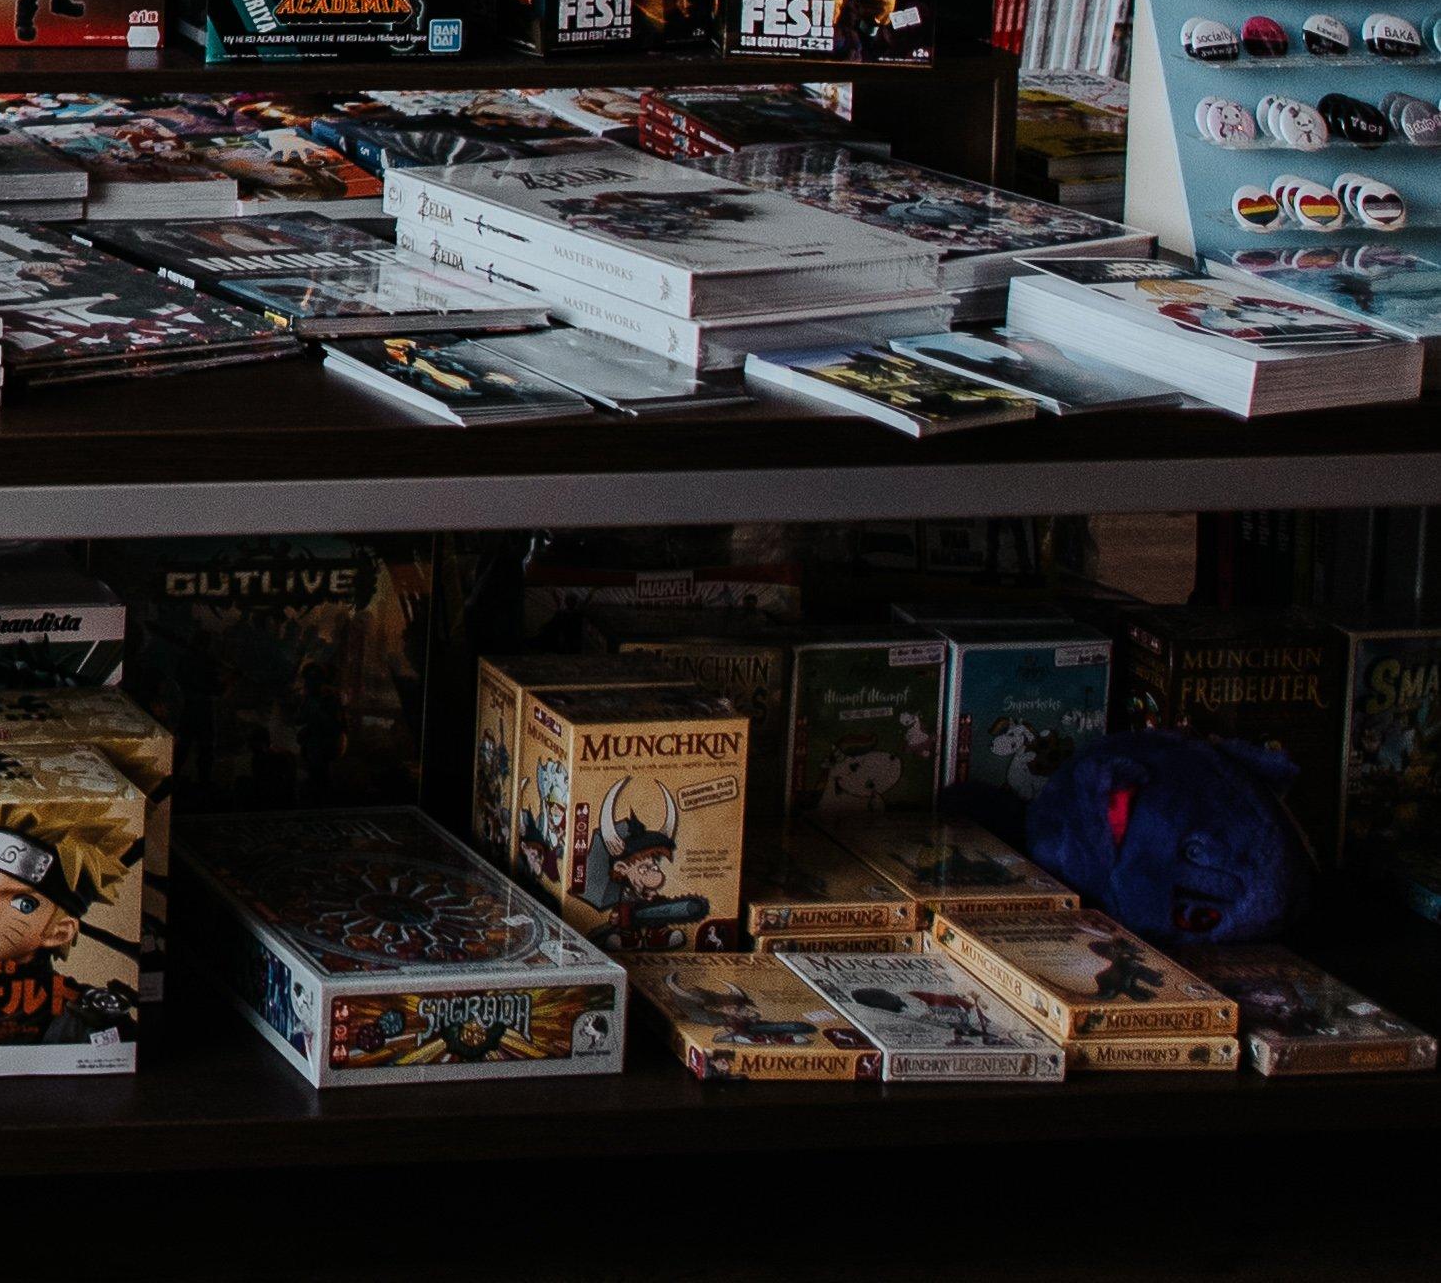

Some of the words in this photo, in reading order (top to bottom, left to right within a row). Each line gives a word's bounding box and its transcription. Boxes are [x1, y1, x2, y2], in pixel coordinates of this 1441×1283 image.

[433, 24, 458, 35] BAN
[433, 36, 454, 47] DAI
[1385, 26, 1415, 43] BAKA
[197, 248, 341, 275] MAKING
[1182, 647, 1323, 673] MUNCHKIN
[1178, 674, 1329, 713] FREIBEUTER
[581, 731, 743, 765] MUNCHKIN
[417, 992, 533, 1037] SAGRADA
[737, 1051, 851, 1076] MUNCHKIN
[952, 1054, 1019, 1076] LEGENDEN
[1093, 1044, 1167, 1067] MUNCHKIN
